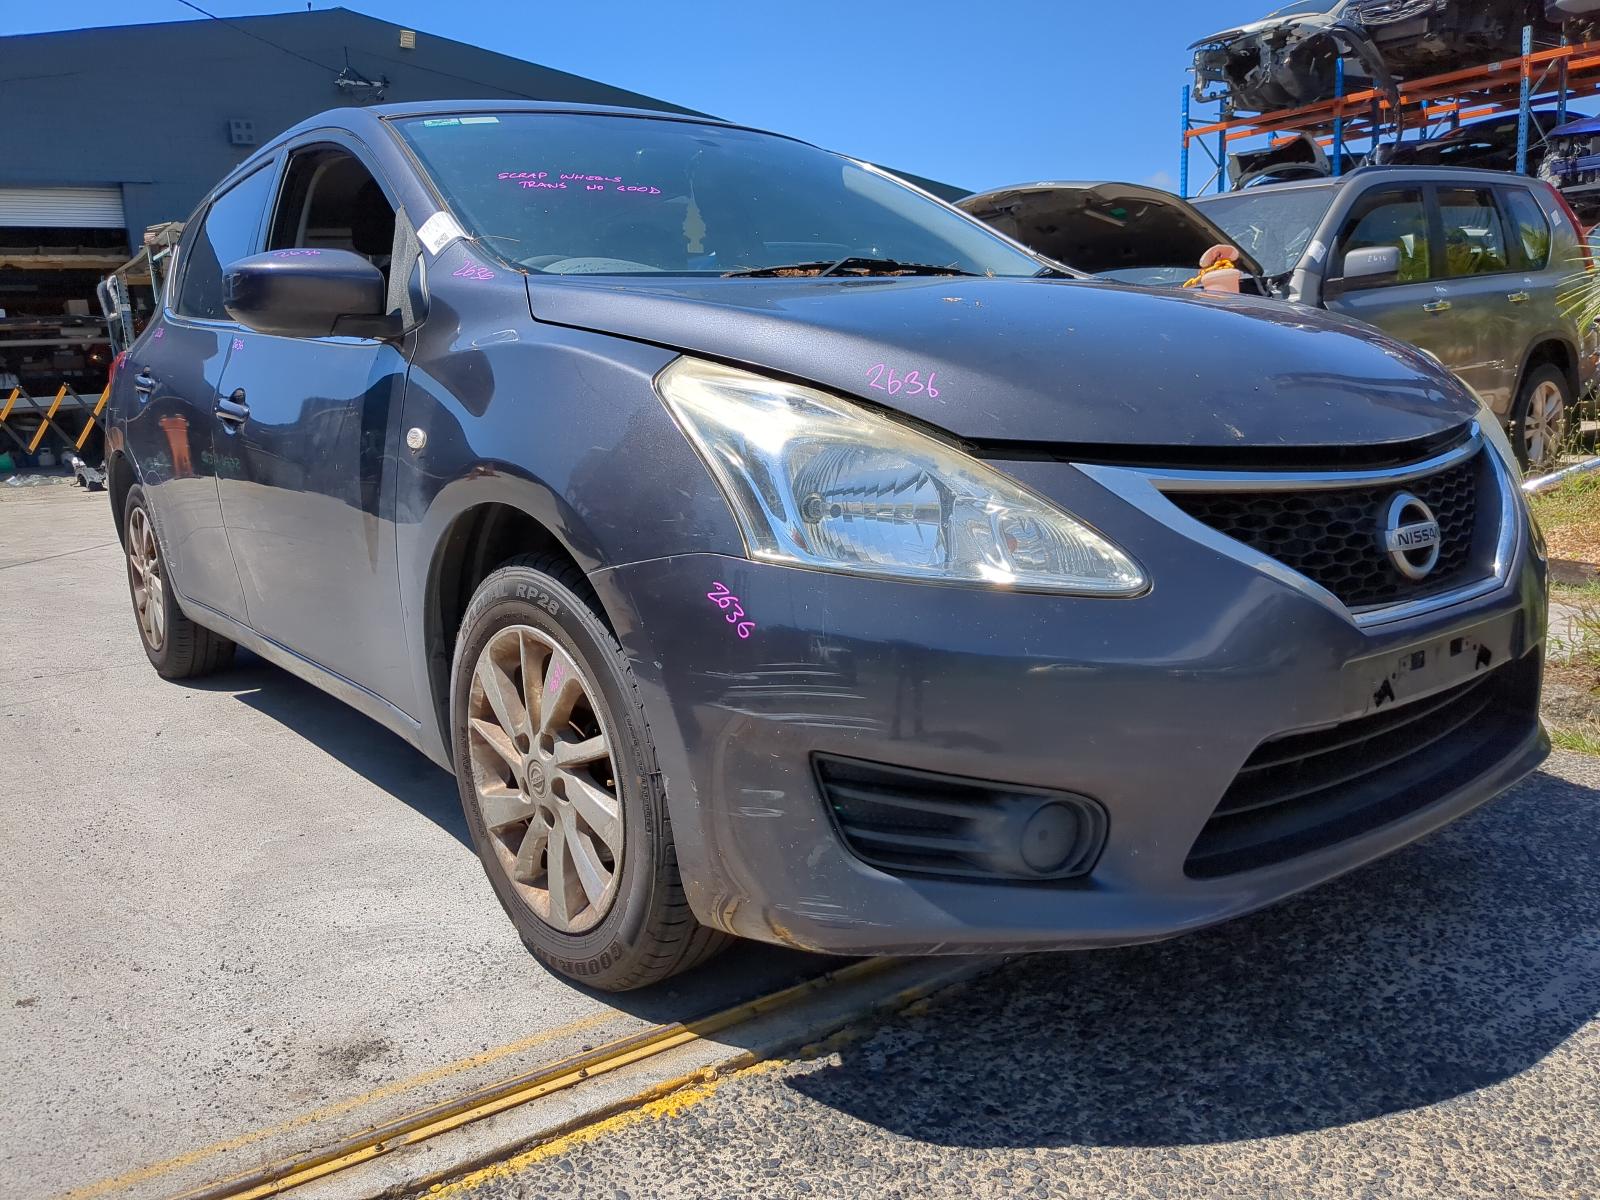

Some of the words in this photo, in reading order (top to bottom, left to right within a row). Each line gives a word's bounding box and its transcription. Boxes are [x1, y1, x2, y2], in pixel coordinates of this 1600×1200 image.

[497, 172, 548, 181] SCRAP
[518, 180, 568, 190] TRANS
[616, 186, 661, 195] GOOD
[865, 363, 939, 398] 2636
[515, 583, 560, 616] RP28
[706, 581, 755, 639] 2636
